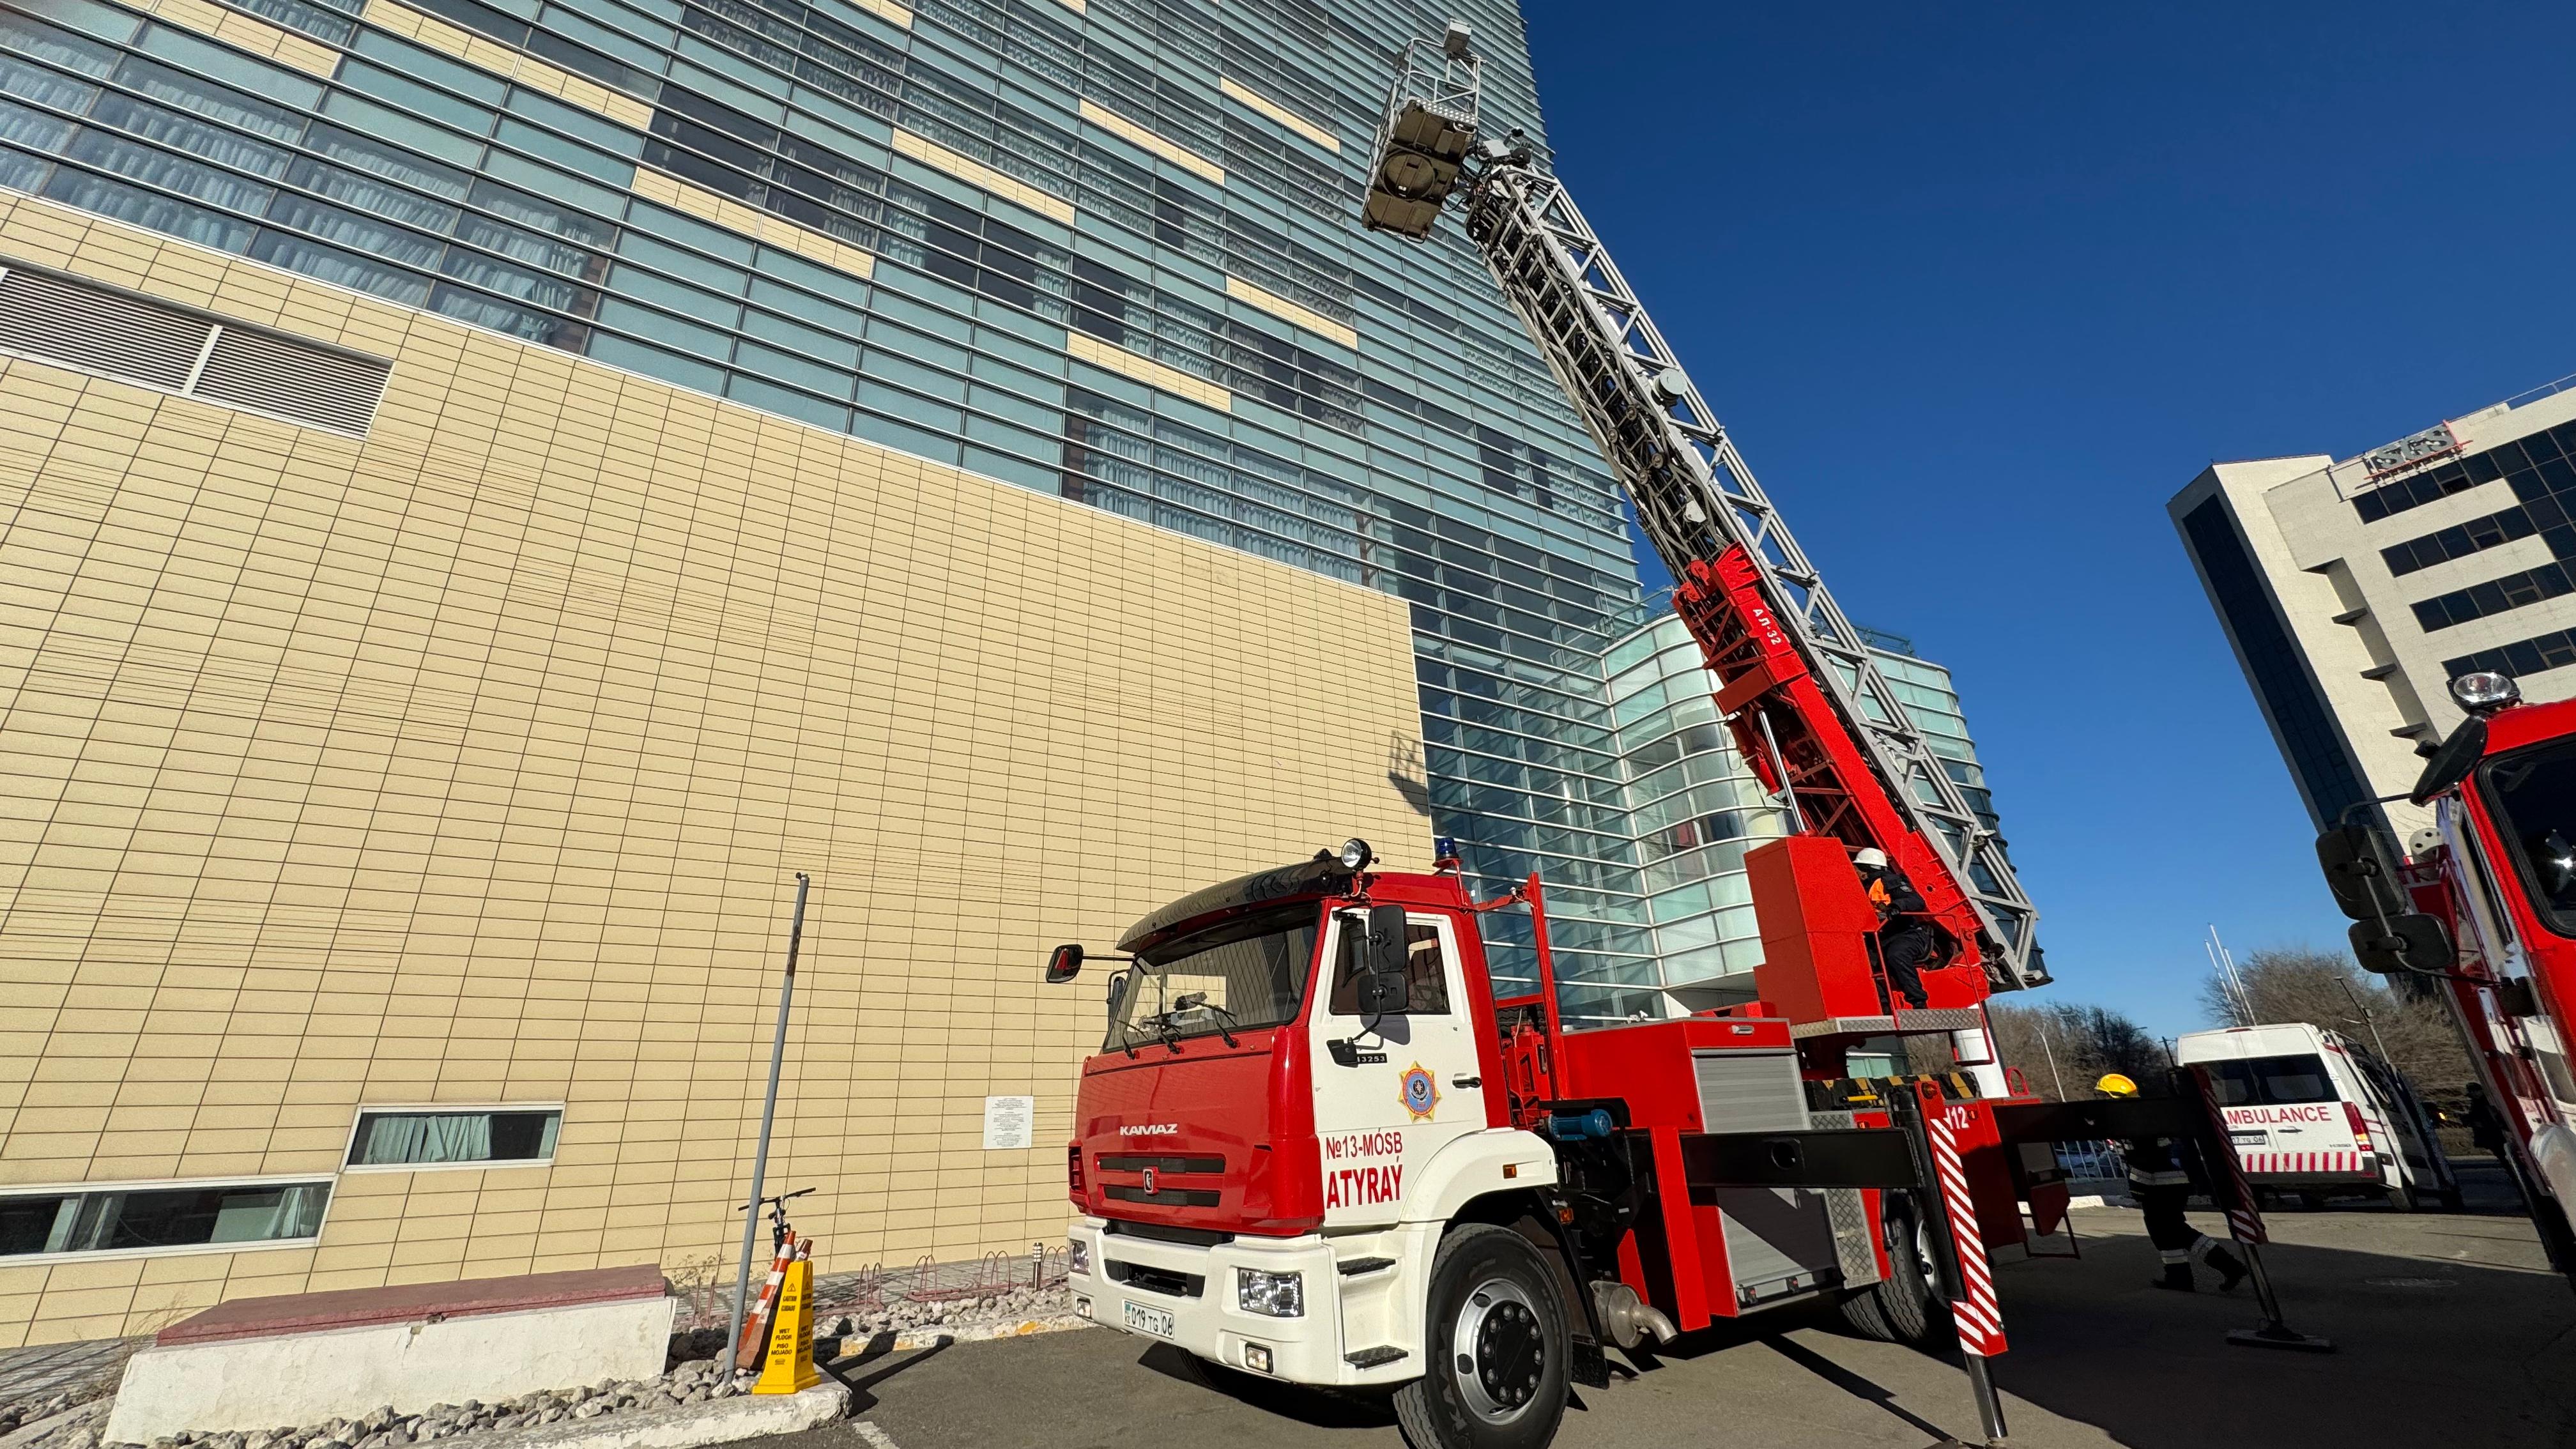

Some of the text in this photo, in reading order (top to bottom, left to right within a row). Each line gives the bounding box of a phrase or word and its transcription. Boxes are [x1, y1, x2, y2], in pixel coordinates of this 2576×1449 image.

[2226, 1106, 2332, 1124] MBULANCE
[1120, 1123, 1177, 1135] KAMAZ
[1326, 1155, 1403, 1209] ATYRAÝ
[1131, 1307, 1146, 1328] 019
[1148, 1315, 1158, 1332] TG
[1162, 1315, 1173, 1336] 06
